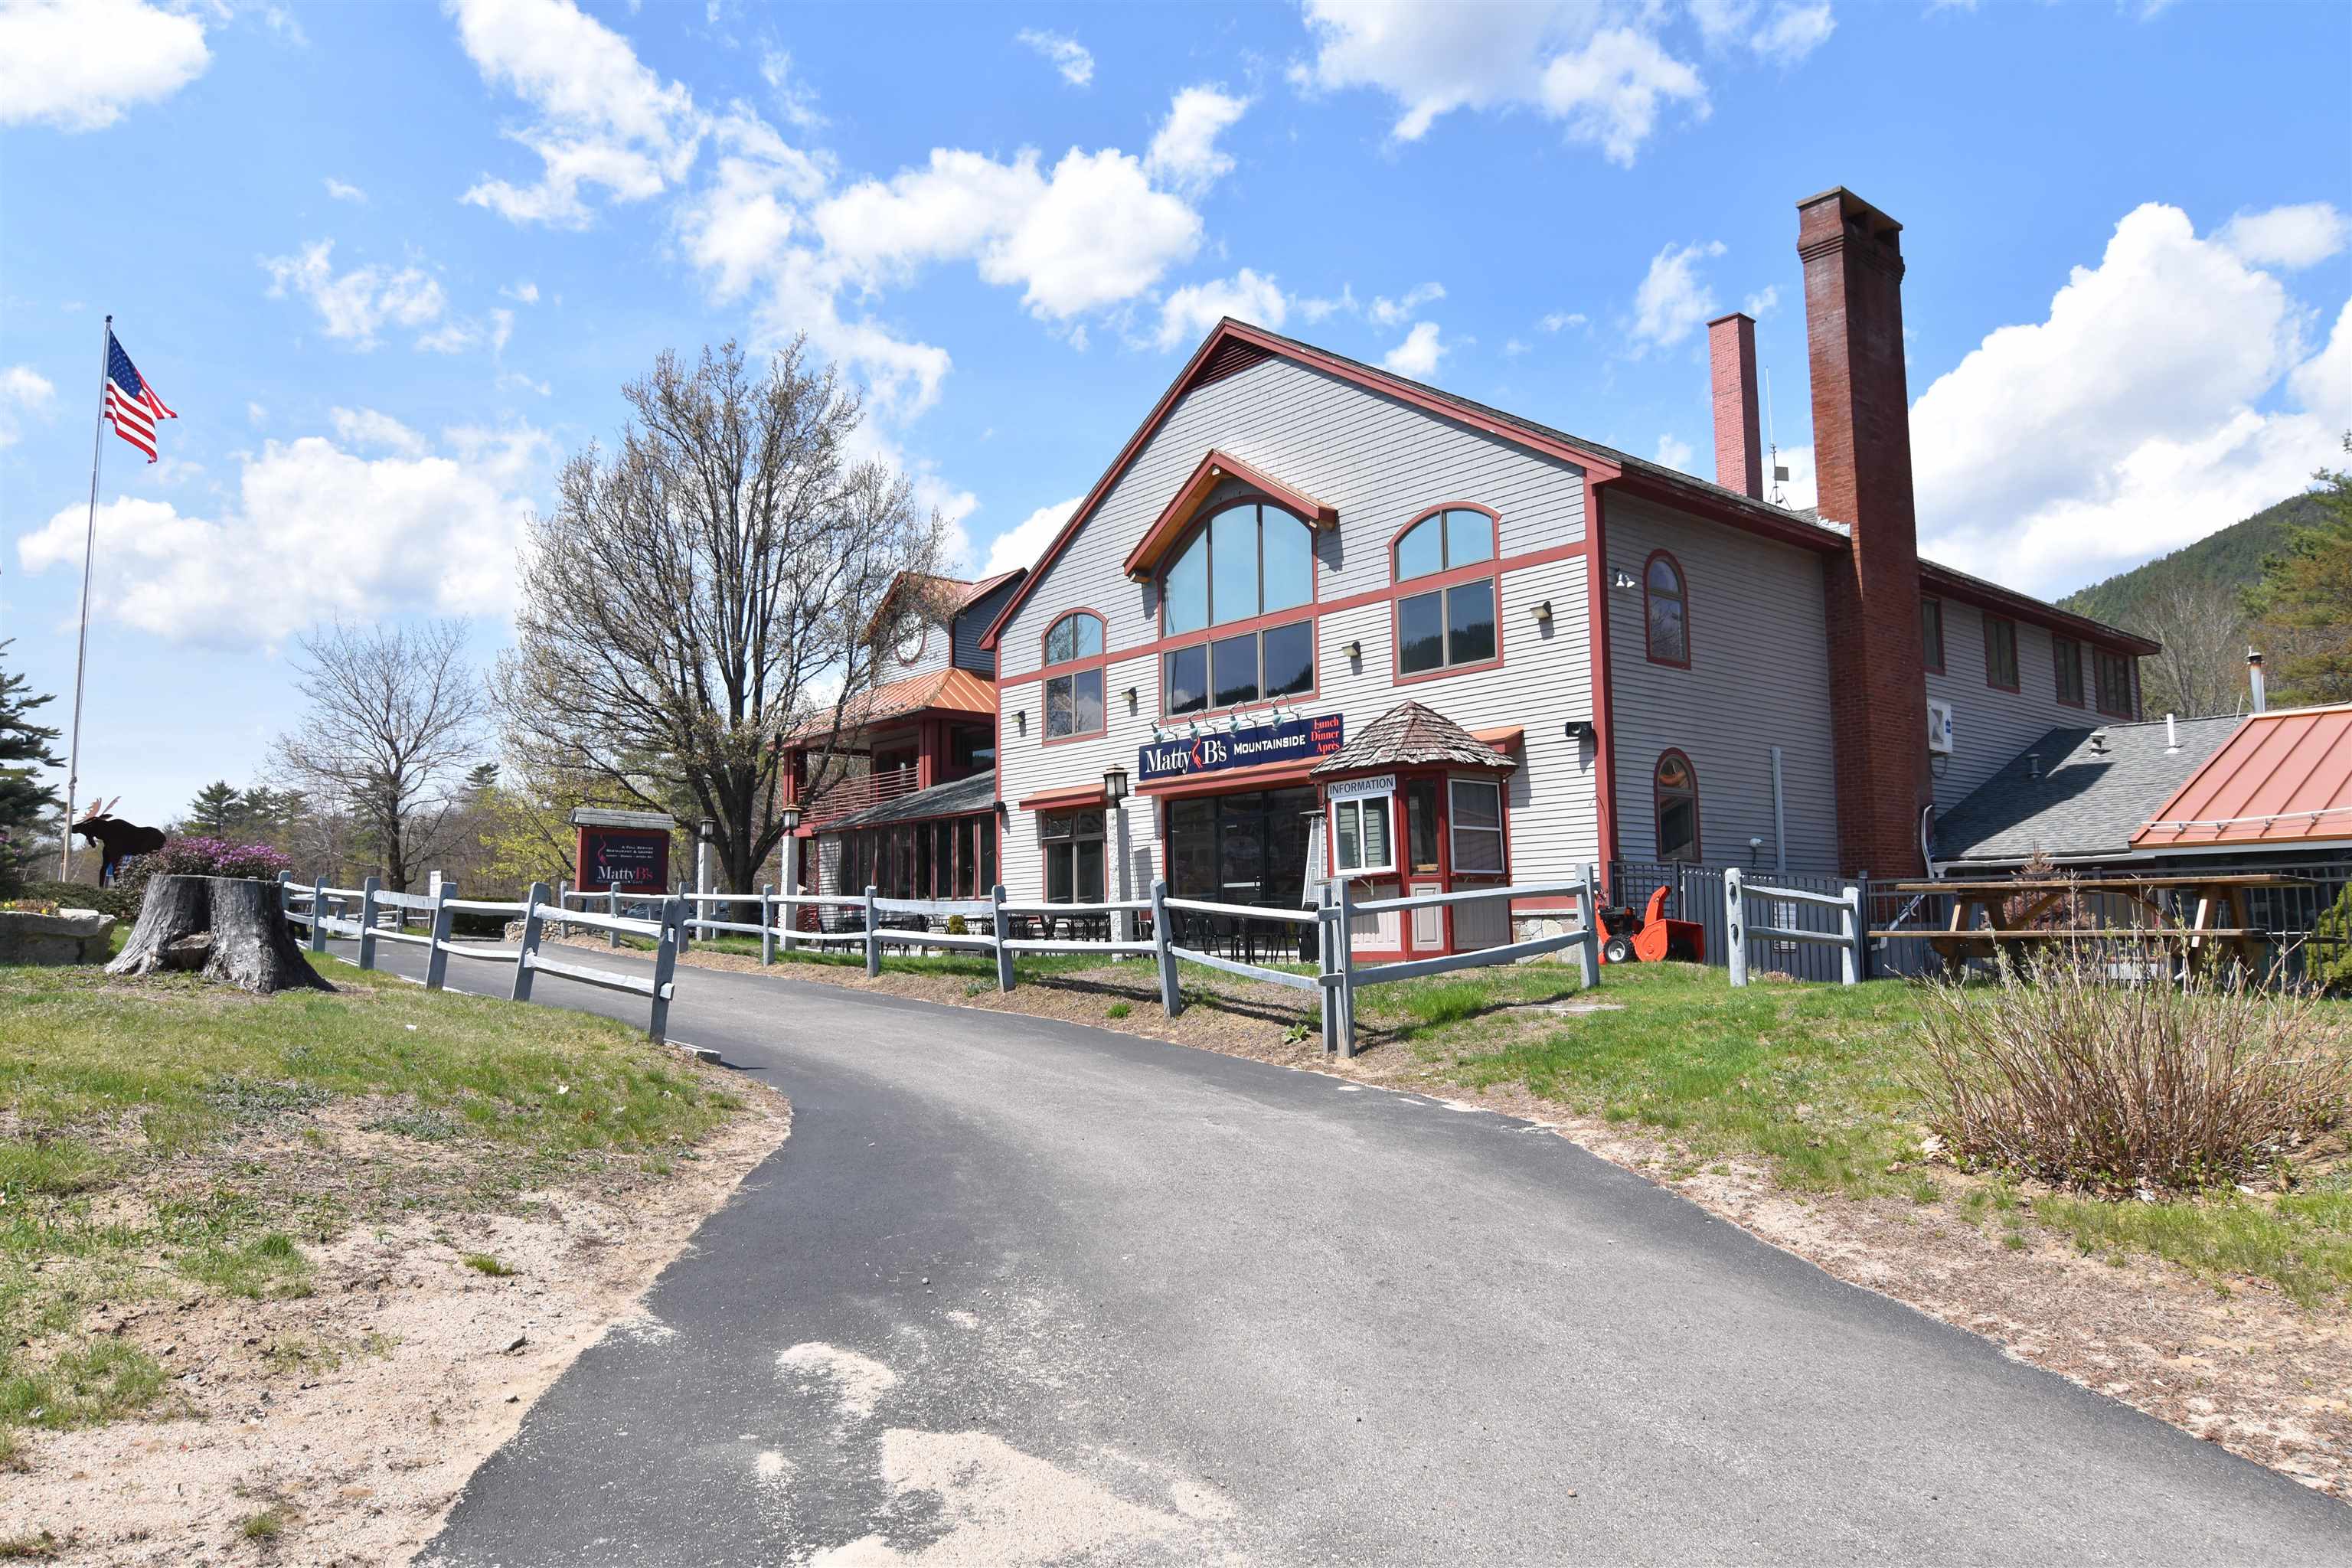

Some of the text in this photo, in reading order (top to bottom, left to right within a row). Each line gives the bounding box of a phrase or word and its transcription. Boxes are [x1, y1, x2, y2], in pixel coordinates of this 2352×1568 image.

[1314, 716, 1339, 730] Lunch
[1311, 730, 1340, 742] Dinner
[1145, 746, 1191, 774] Matty
[1201, 740, 1227, 764] B's
[1329, 777, 1394, 795] INFORMATION
[597, 866, 635, 883] Matty
